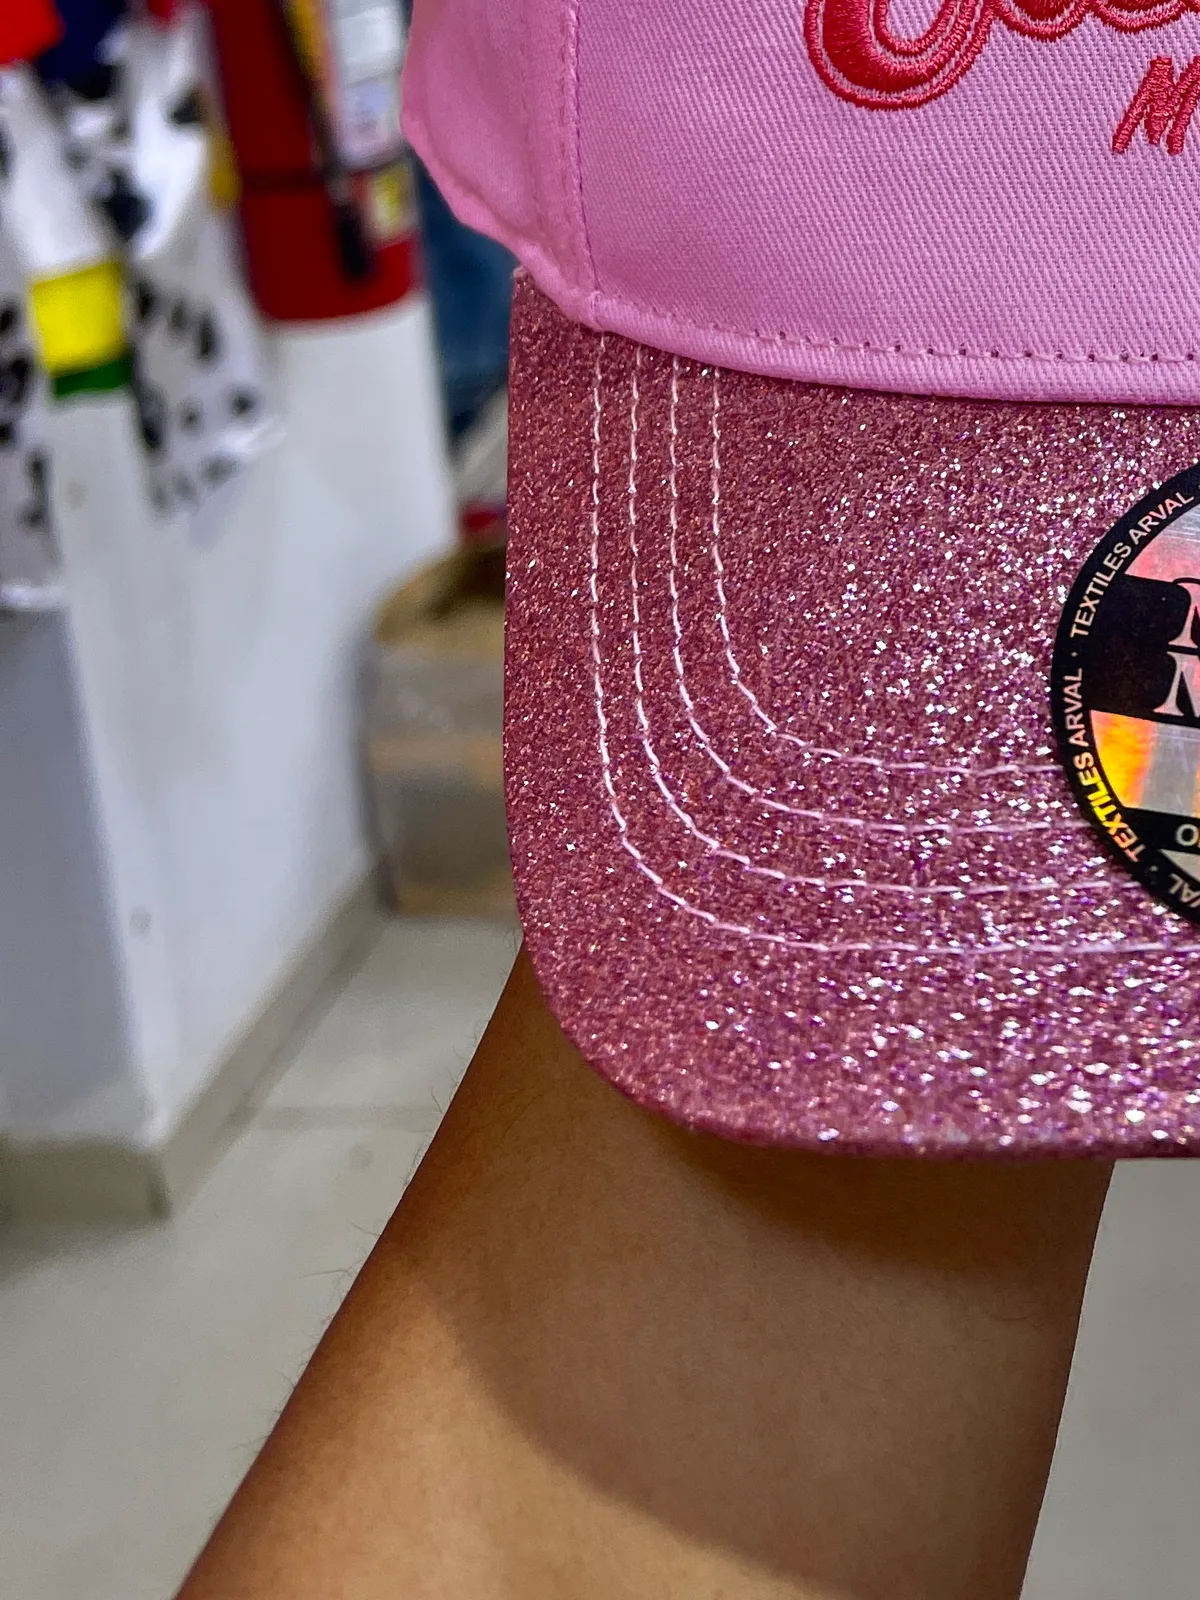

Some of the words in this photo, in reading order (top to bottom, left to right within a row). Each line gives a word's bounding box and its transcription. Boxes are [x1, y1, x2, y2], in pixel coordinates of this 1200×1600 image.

[1070, 543, 1132, 639] TEXTILES
[1130, 492, 1194, 548] ARVAL
[1063, 667, 1084, 747] ARVAL
[1075, 752, 1146, 862] TEXTILES
